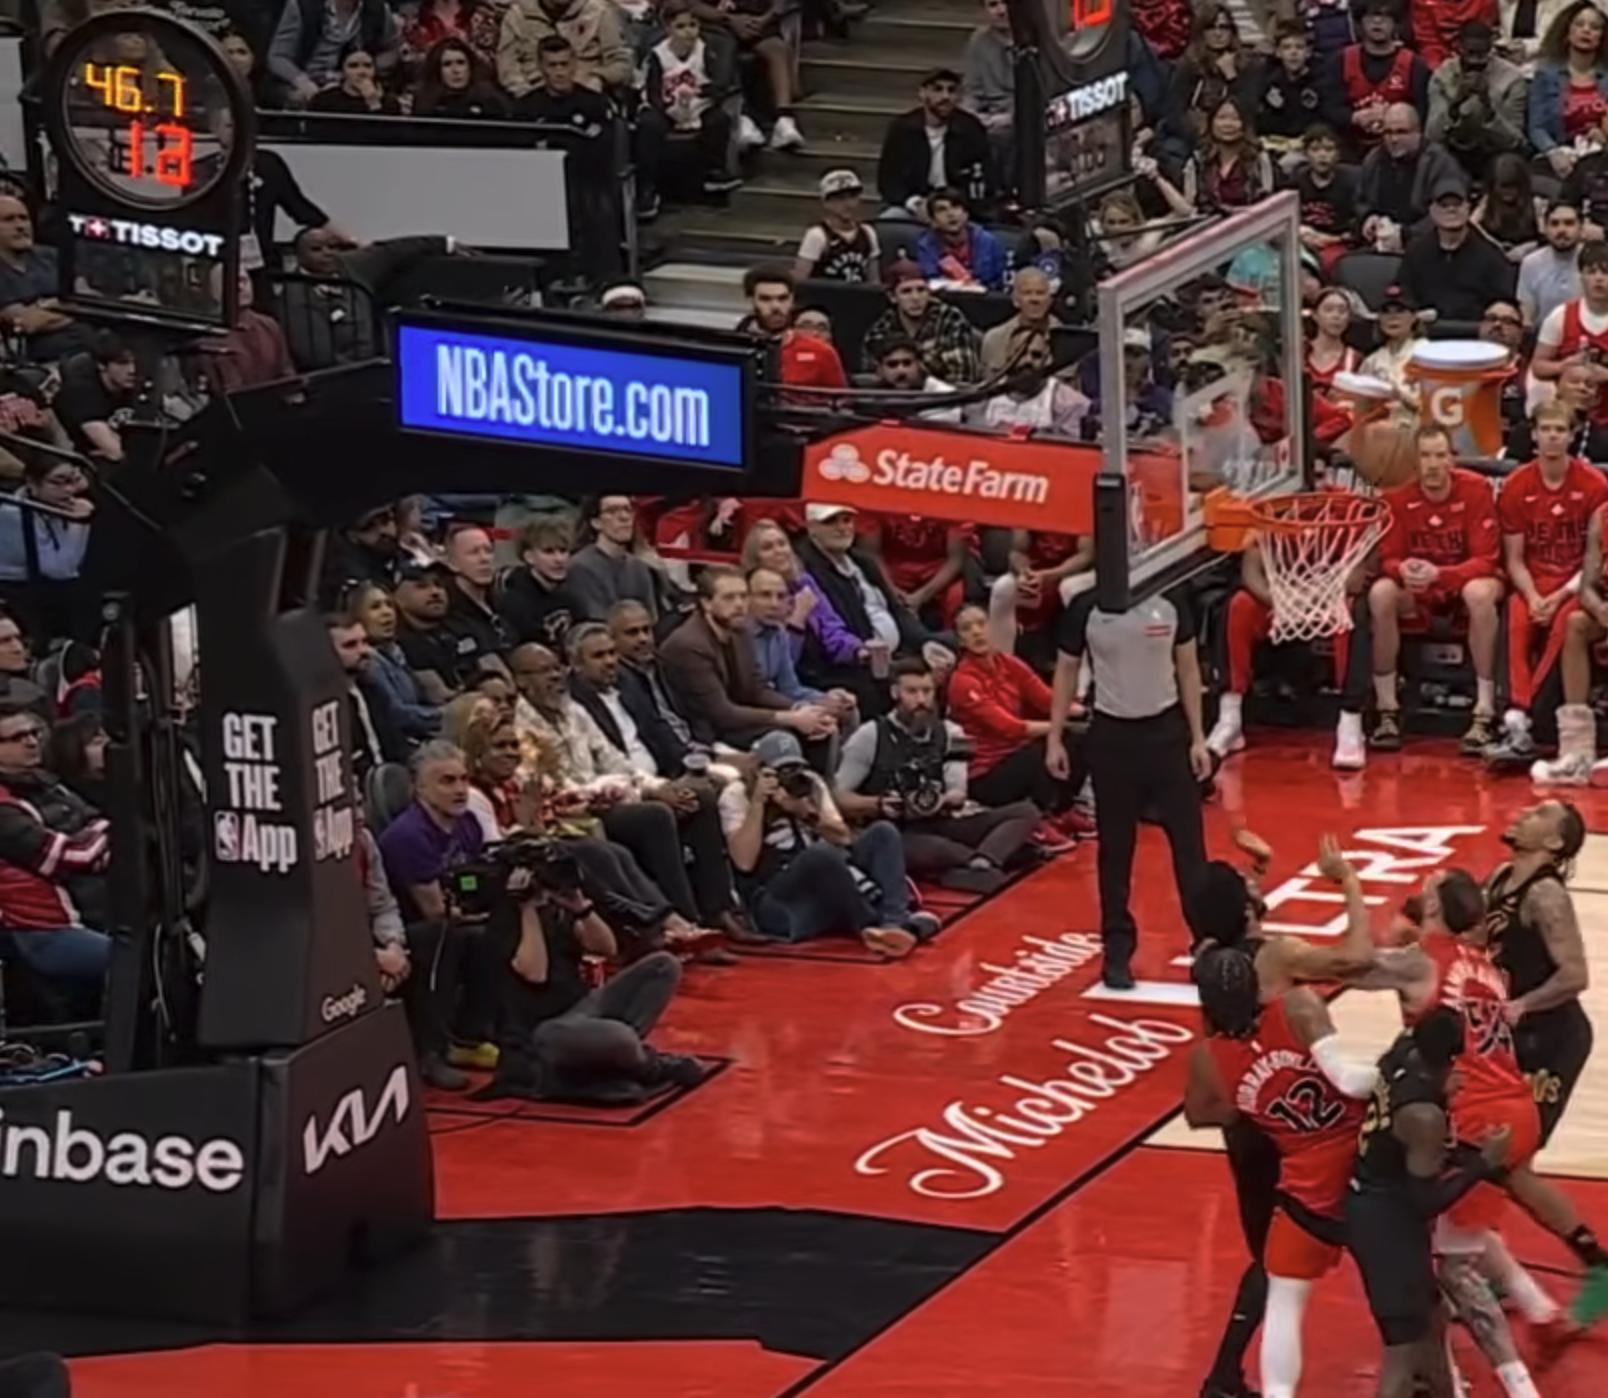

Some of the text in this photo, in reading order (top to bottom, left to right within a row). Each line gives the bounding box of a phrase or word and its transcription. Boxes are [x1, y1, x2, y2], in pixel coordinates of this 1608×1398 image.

[86, 64, 186, 117] 46.7
[1067, 71, 1128, 120] TISSOT
[110, 219, 224, 256] TISSOT
[436, 344, 710, 447] NBAStore.com
[1431, 387, 1463, 426] G
[223, 713, 277, 761] GET
[313, 700, 339, 755] GET
[224, 762, 281, 811] THE
[315, 750, 345, 803] THE
[241, 814, 297, 873] App
[321, 984, 366, 1021] Google
[893, 931, 1104, 1035] Courtside
[855, 1013, 1194, 1199] Michelob
[1265, 1076, 1346, 1131] 12
[0, 1107, 244, 1191] nbase
